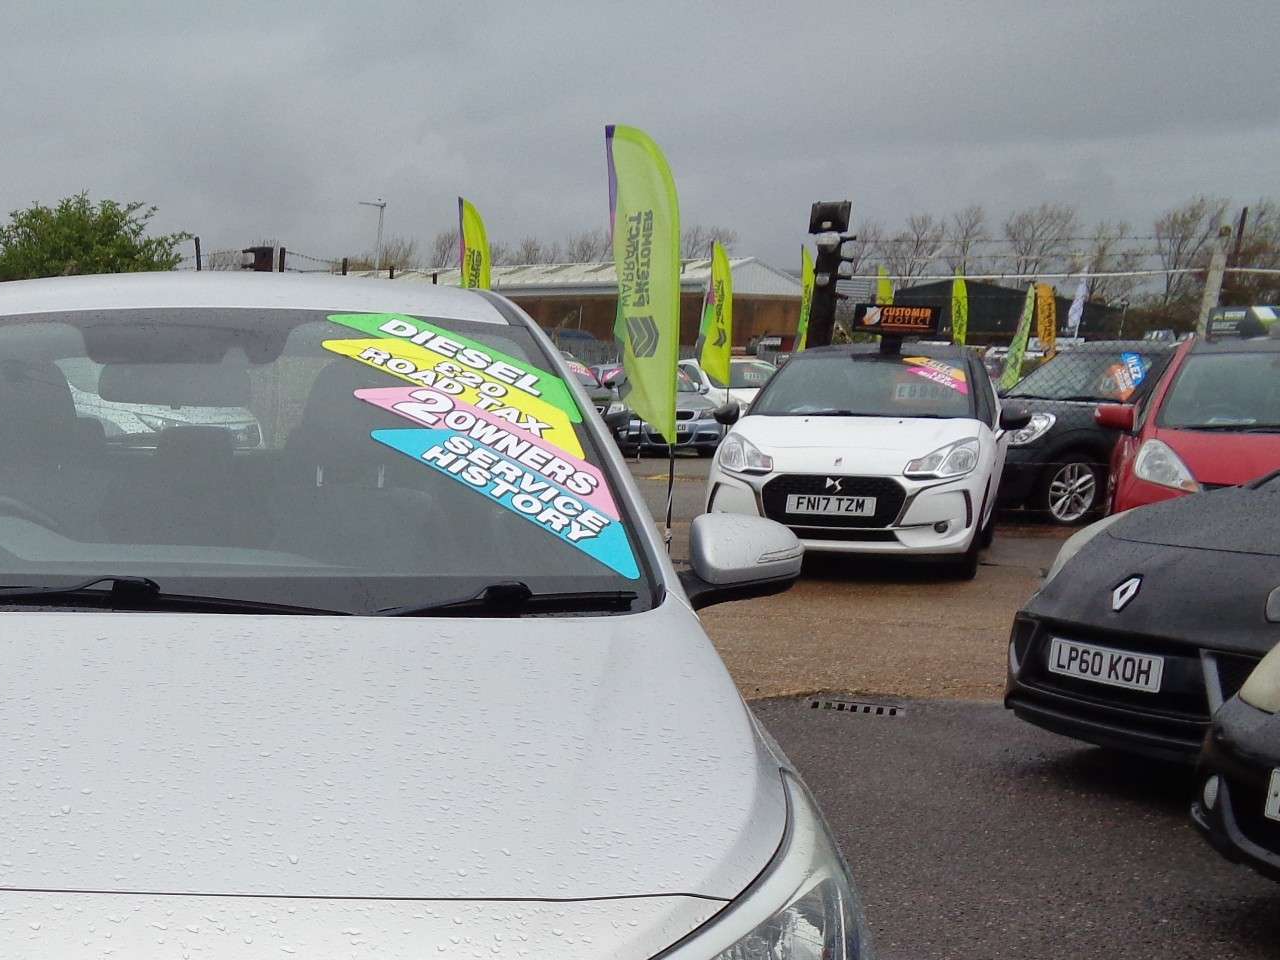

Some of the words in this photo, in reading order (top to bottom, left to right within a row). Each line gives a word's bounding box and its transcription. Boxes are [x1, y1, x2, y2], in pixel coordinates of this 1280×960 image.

[881, 316, 931, 325] PROTECT
[883, 306, 932, 317] CUSTOMER
[378, 318, 542, 397] DIESEL
[433, 361, 508, 398] £20
[359, 347, 465, 396] ROAD
[472, 393, 555, 438] TAX
[392, 389, 456, 426] 2
[443, 409, 599, 496] OWNERS
[421, 445, 600, 543] HISTORY
[443, 435, 611, 532] SERVICE
[796, 496, 830, 511] FN17
[836, 497, 865, 512] TZM
[1056, 644, 1104, 677] LP60
[1107, 653, 1153, 685] KOH
